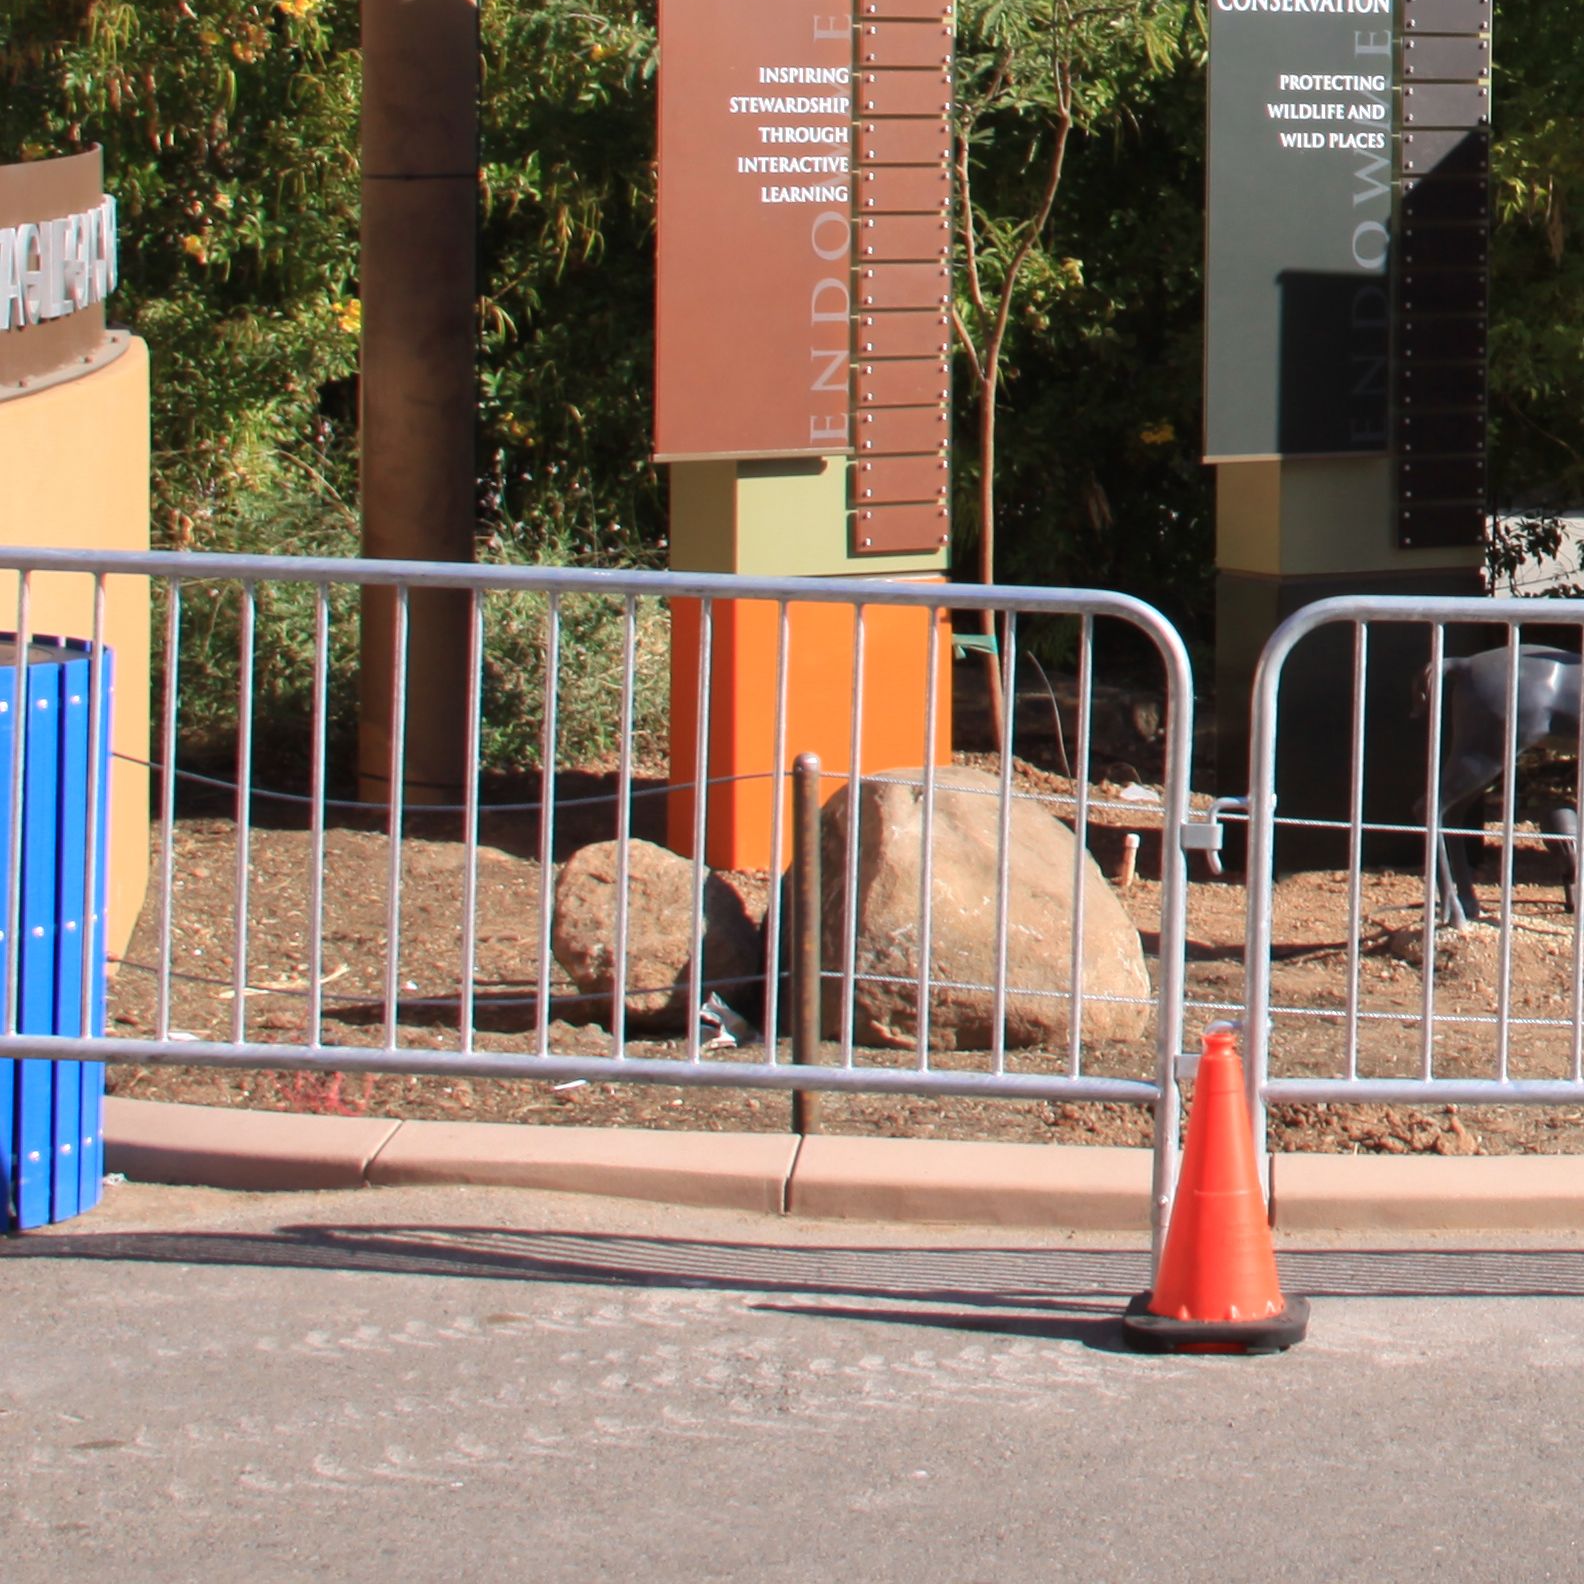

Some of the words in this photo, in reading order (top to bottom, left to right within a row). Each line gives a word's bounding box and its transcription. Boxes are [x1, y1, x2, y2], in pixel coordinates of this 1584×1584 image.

[759, 67, 849, 84] INSPIRING
[1280, 74, 1385, 91] PROTECTING
[729, 97, 850, 114] STEWARDSHIP
[1267, 103, 1345, 119] WILDLIFE
[1347, 104, 1385, 120] AND
[758, 126, 848, 144] THROUGH
[1280, 132, 1325, 149] WILD
[1329, 133, 1385, 149] PLACES
[738, 157, 849, 173] INTERACTIVE
[761, 186, 848, 203] LEARNING
